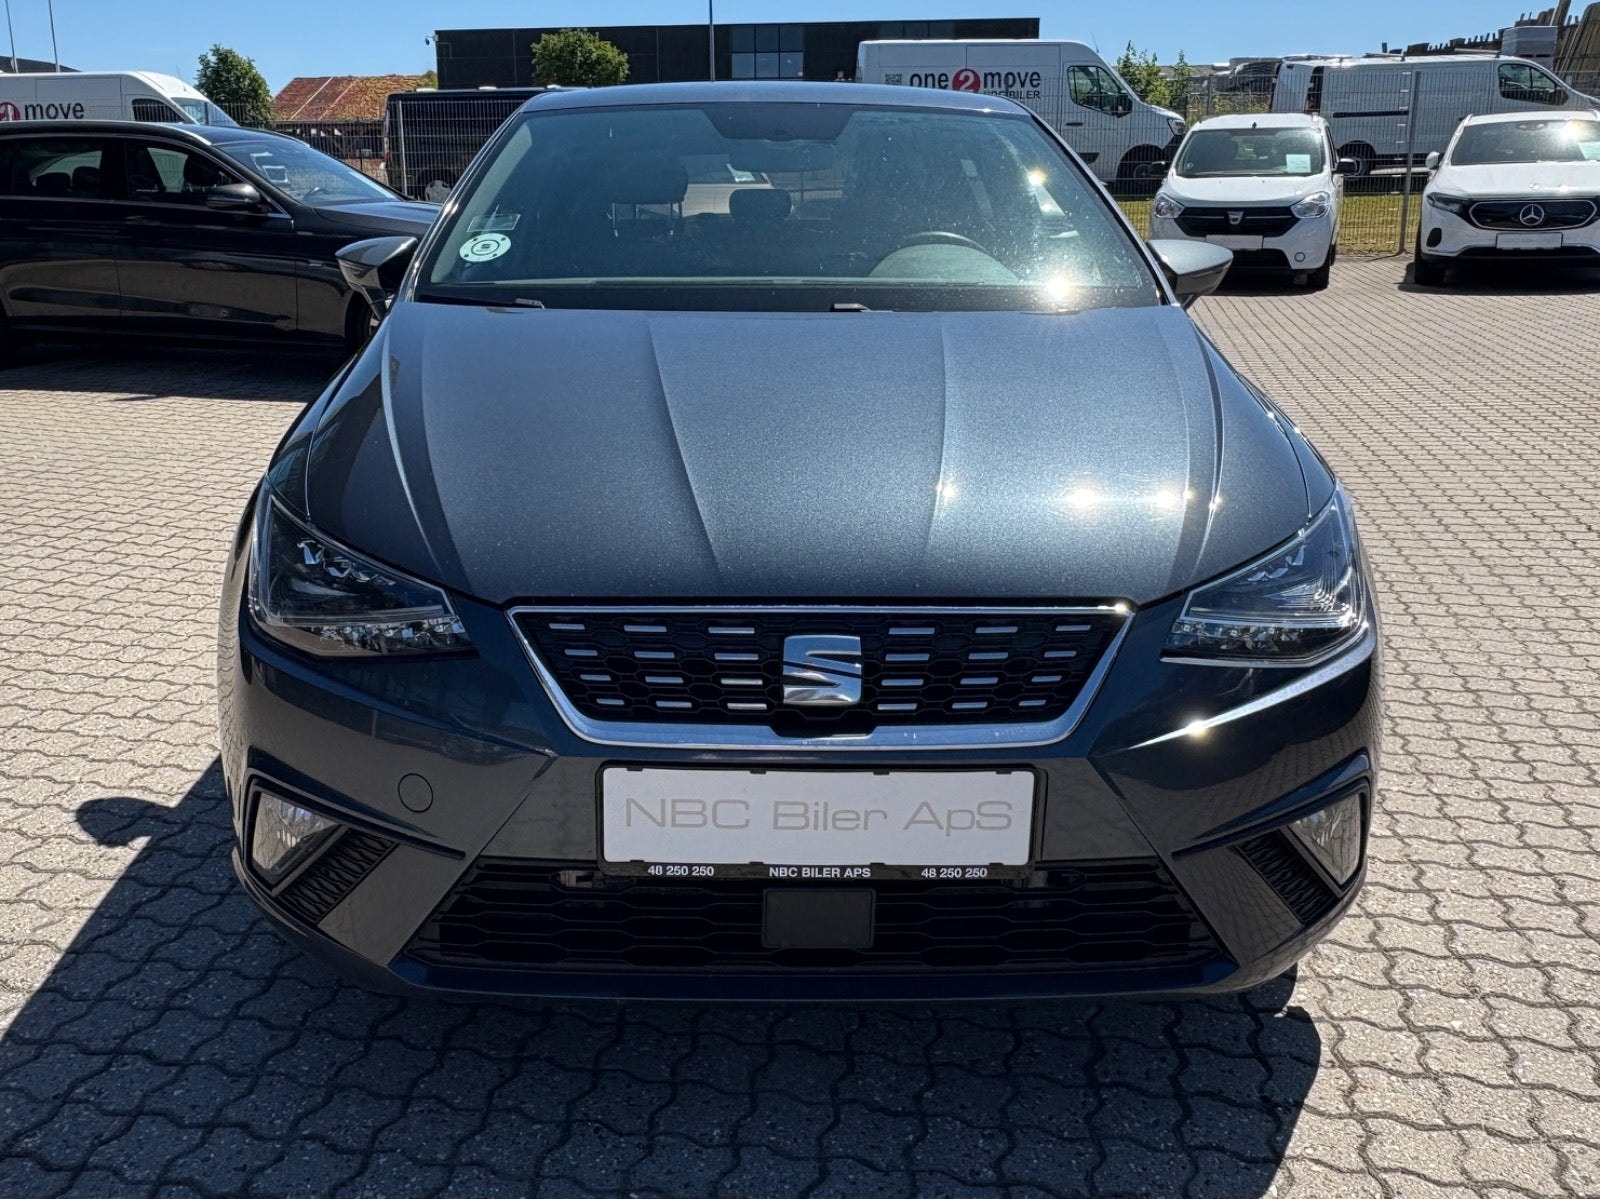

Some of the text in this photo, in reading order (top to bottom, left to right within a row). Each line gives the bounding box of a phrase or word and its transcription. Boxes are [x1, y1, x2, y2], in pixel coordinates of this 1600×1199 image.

[24, 102, 85, 120] move
[625, 797, 1013, 836] NBC Biler ApS
[647, 865, 715, 877] 48 250 250
[769, 867, 871, 878] NBC BILER APS
[921, 867, 988, 878] 48 250 250
